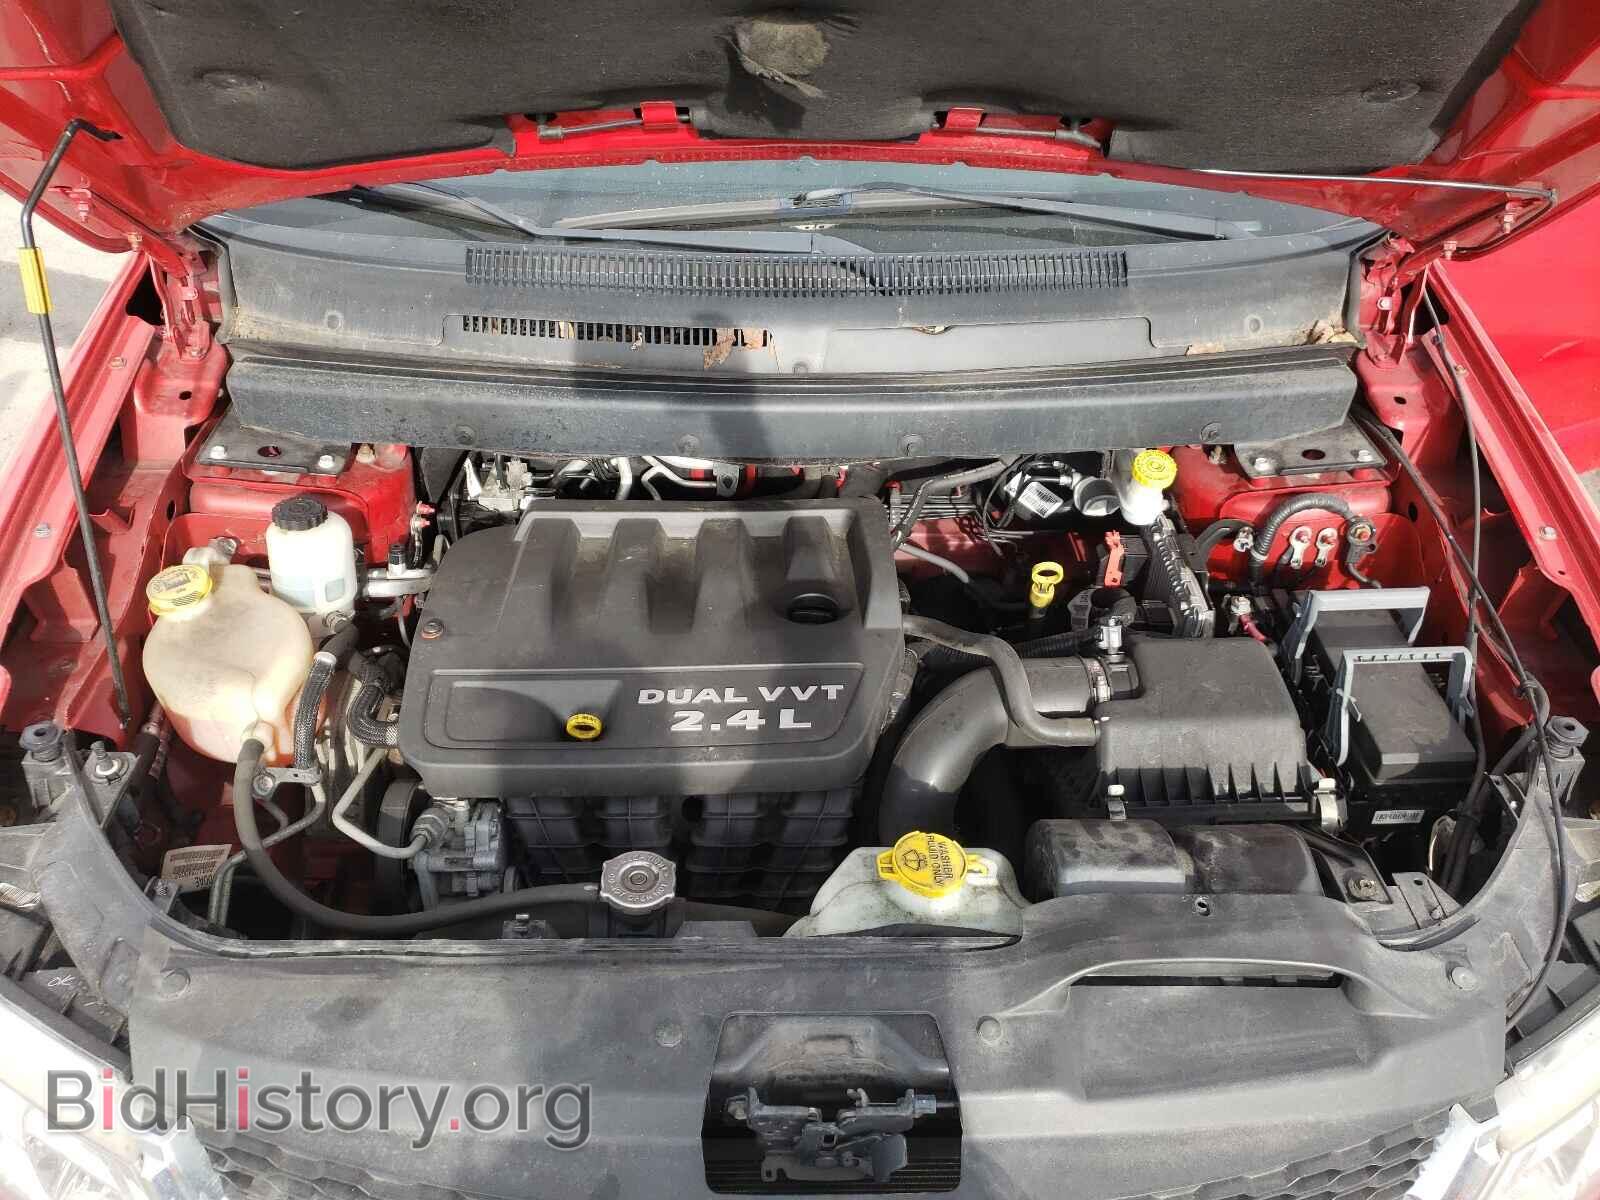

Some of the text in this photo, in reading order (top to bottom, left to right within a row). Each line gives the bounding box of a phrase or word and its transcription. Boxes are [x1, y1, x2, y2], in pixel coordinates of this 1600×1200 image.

[637, 684, 844, 704] DUAL VVT
[671, 708, 812, 731] 2.4 L
[926, 835, 945, 888] FLUID ONLY
[937, 841, 954, 880] WASHER
